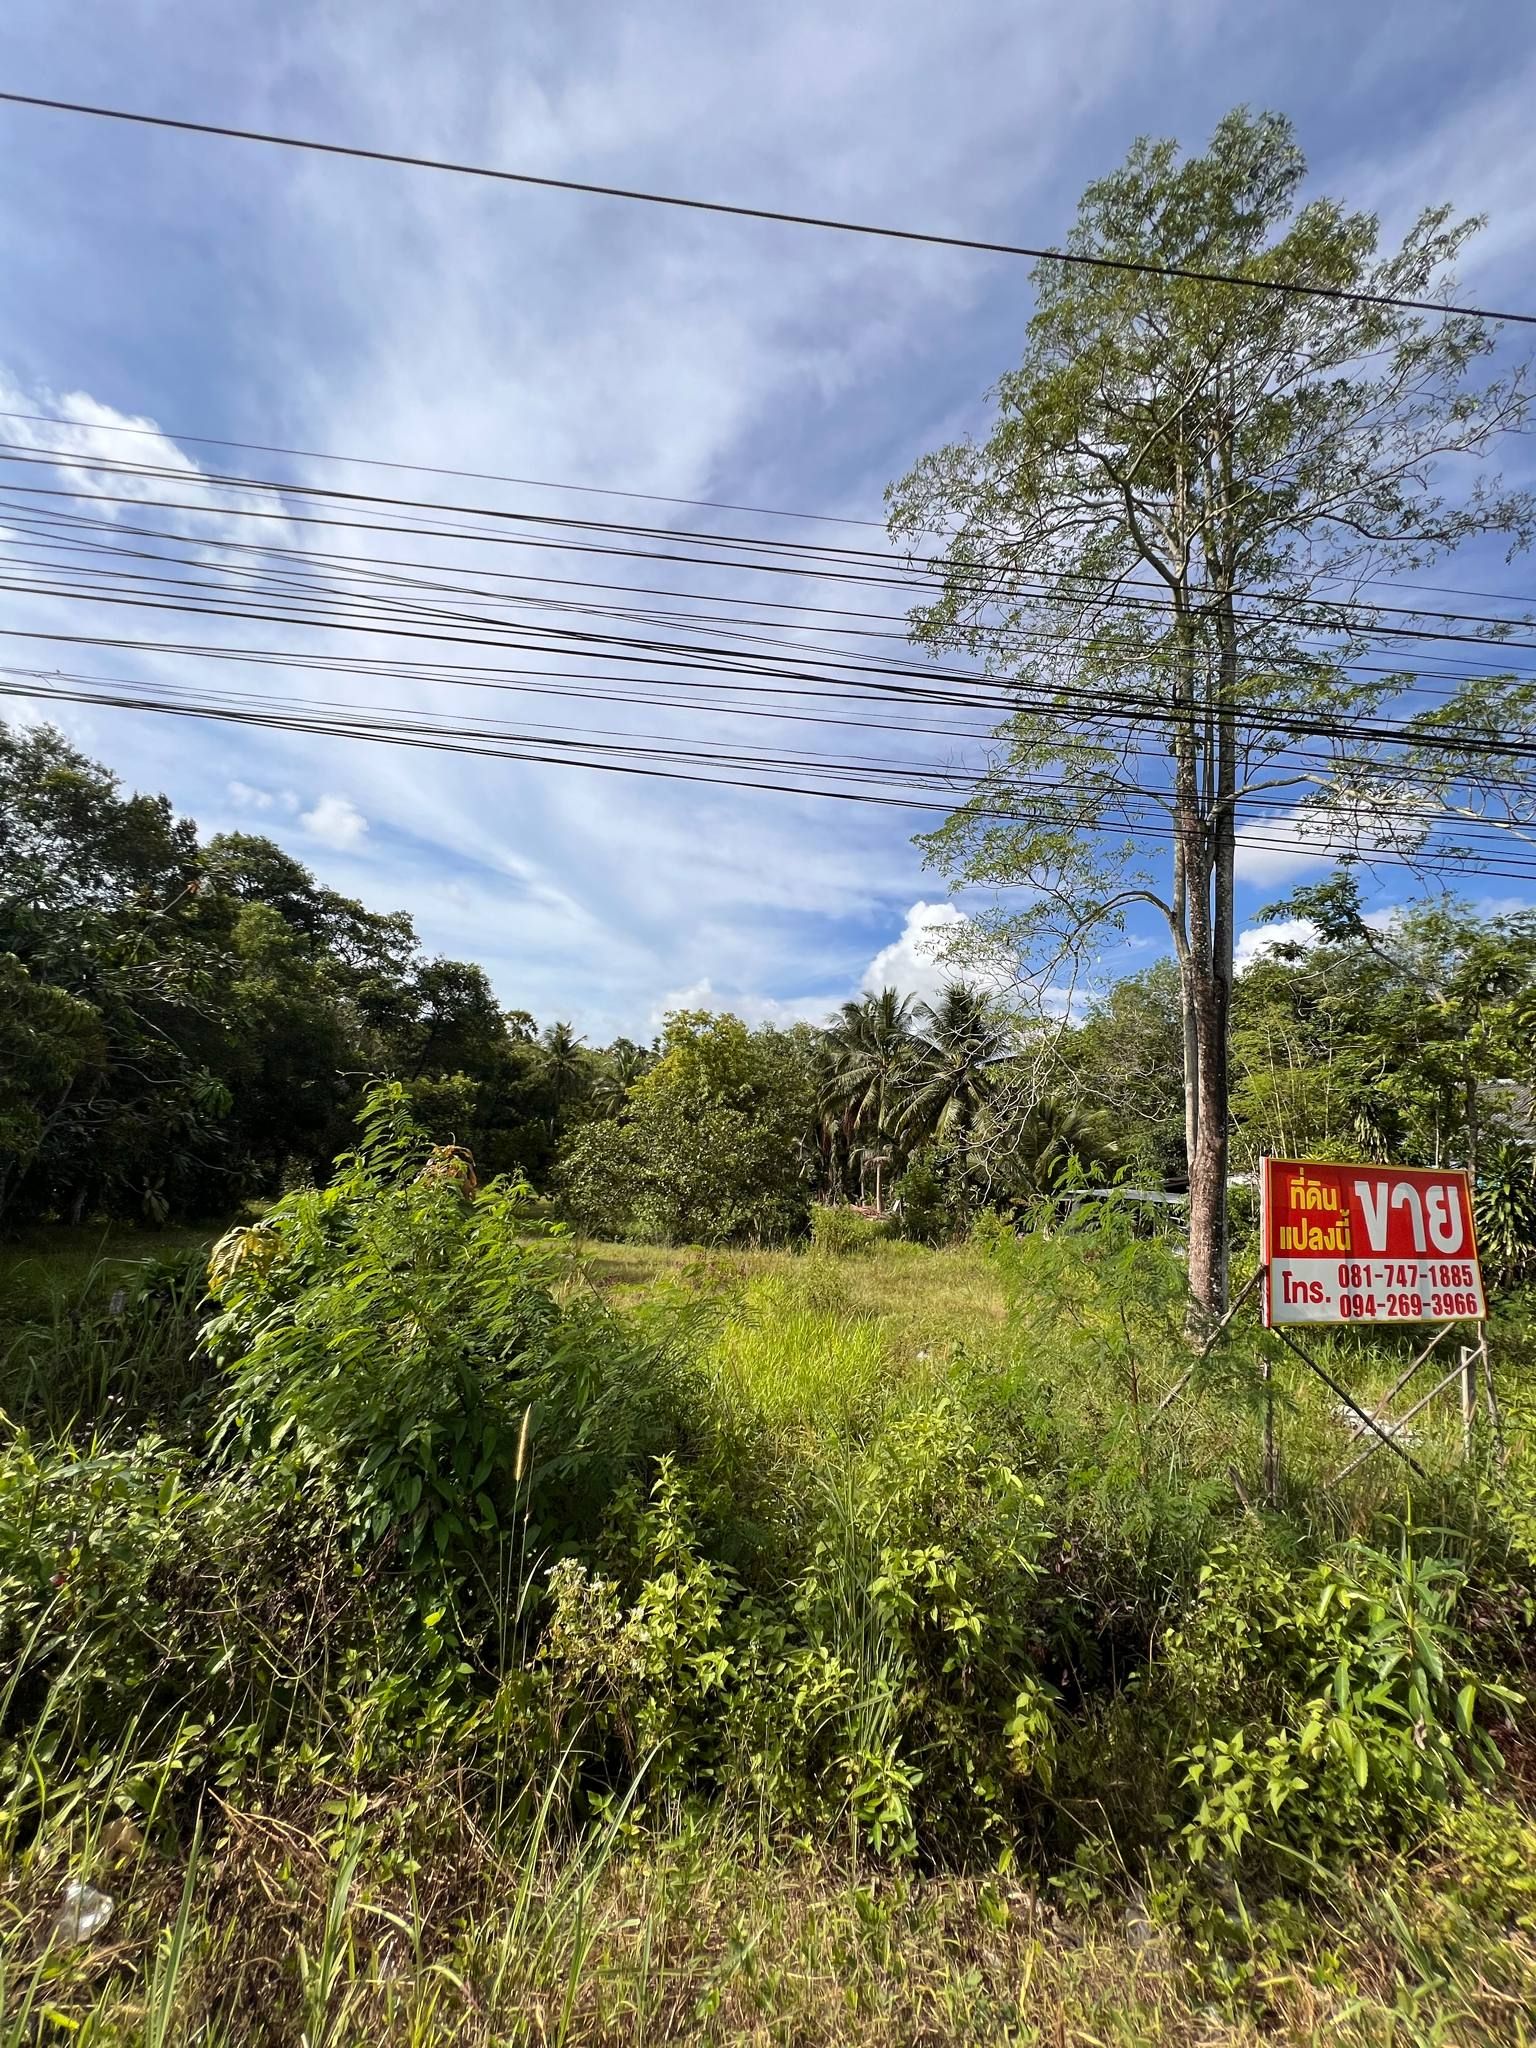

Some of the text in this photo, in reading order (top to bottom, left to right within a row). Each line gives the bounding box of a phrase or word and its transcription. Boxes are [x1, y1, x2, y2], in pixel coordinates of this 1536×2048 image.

[1290, 1167, 1337, 1211] ที่ดิน
[1279, 1208, 1351, 1251] แปลงนี้
[1354, 1180, 1464, 1254] ขาย
[1281, 1264, 1473, 1304] โทร. 081-747-1885
[1339, 1293, 1478, 1318] 094-269-3966
